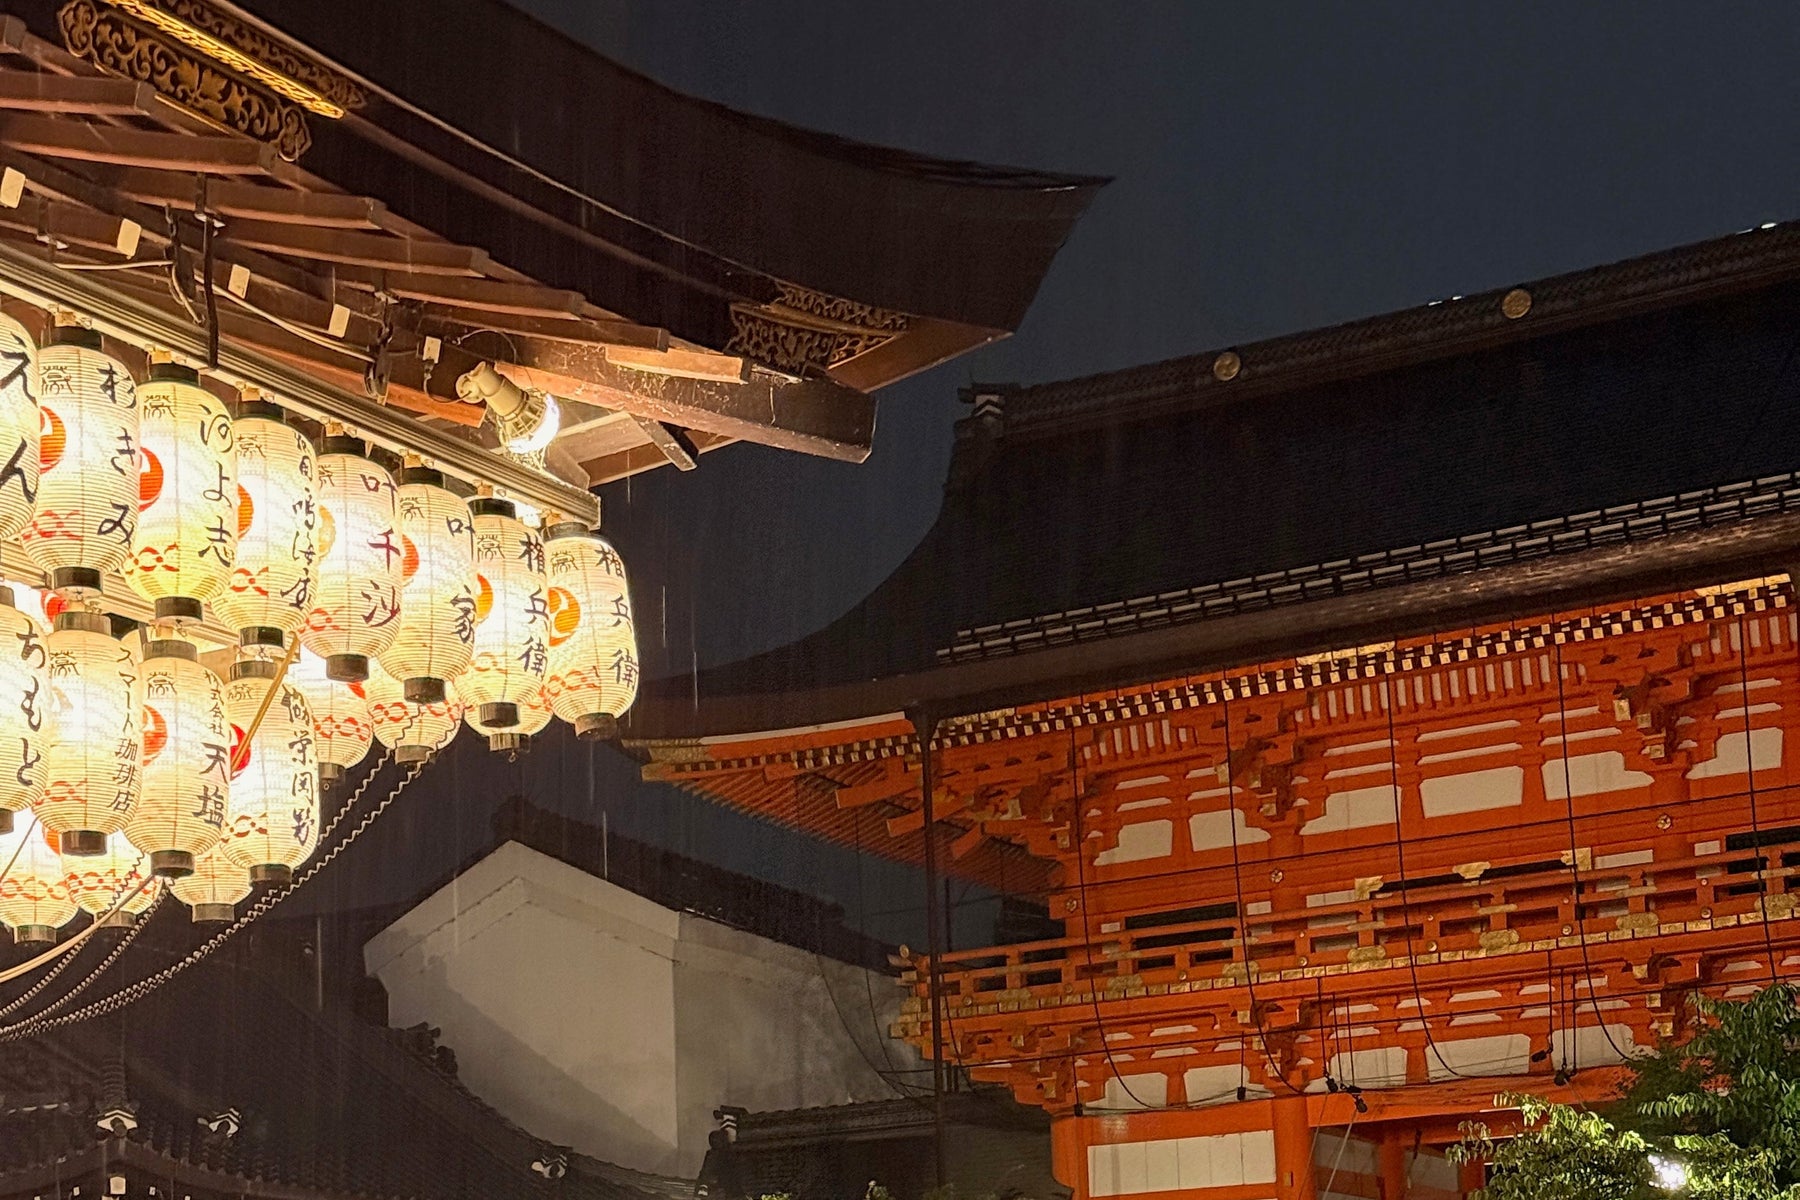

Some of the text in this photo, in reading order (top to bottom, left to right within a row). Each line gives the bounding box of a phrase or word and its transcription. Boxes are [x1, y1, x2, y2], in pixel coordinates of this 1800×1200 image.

[106, 646, 139, 815] スマート珈琲店
